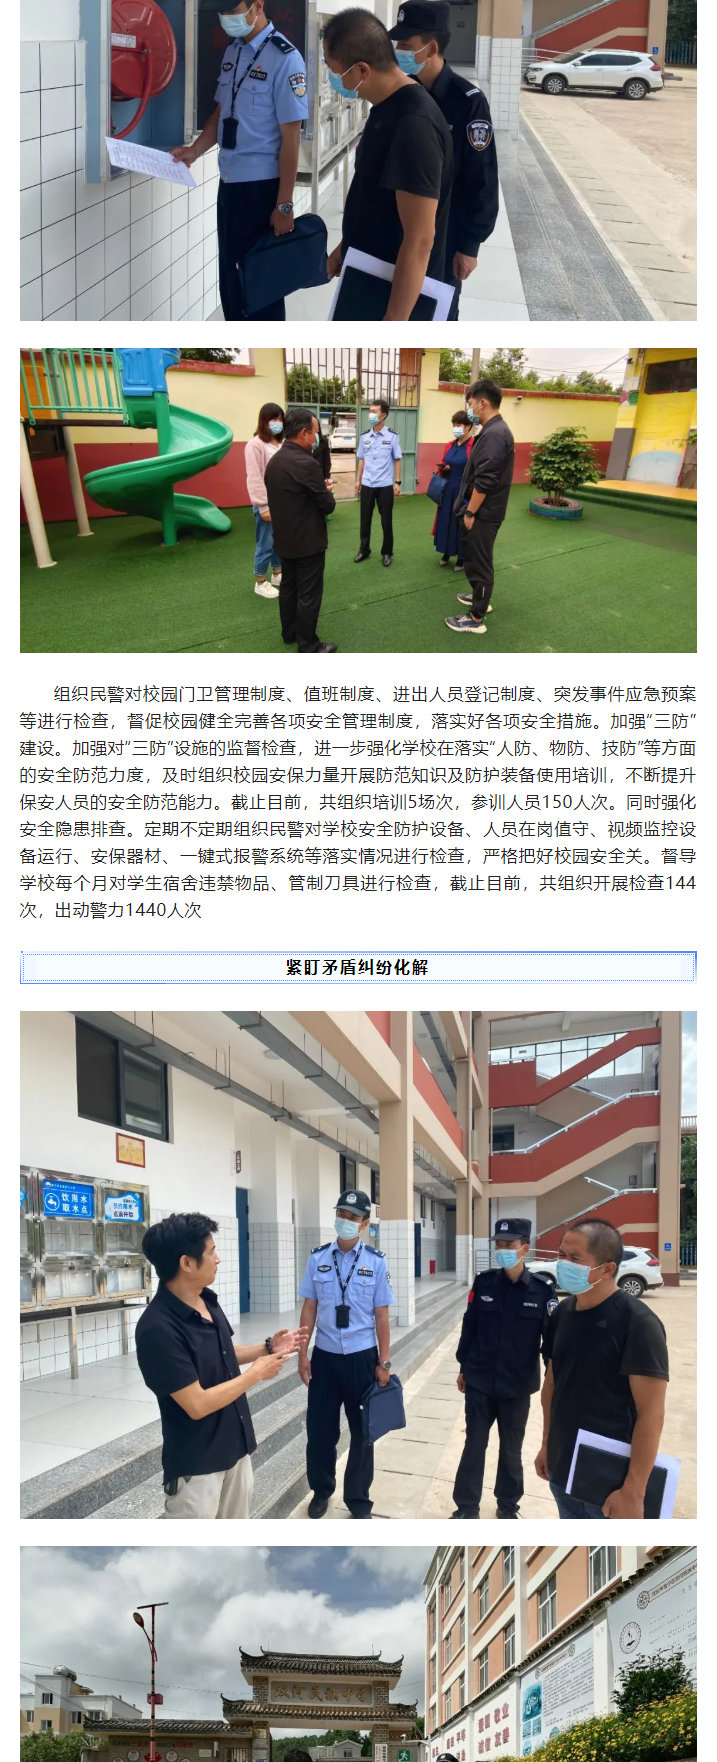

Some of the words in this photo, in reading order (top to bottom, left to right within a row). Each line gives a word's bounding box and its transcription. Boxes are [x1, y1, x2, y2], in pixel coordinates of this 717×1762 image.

[53, 684, 697, 704] 组织民警对校园门卫管理制度、值班制度、进出人员登记制度、突发事件应急预案
[19, 765, 697, 785] 的安全防范力度，及时组织校园安保力量开展防范知识及防护装备使用培训，不断提升
[19, 792, 697, 812] 保安人员的安全防范能力。截止目前，共组织培训5场次，参训人员150人次。同时强化
[19, 819, 697, 839] 安全隐患排查。定期不定期组织民警对学校安全防护设备、人员在岗值守、视频监控设
[19, 846, 697, 866] 备运行、安保器材、一键式报警系统等落实情况进行检查，严格把好校园安全关。督导
[19, 873, 697, 893] 学校每个月对学生宿舍违禁物品、管制刀具进行检查，截止目前，共组织开展检查144
[19, 901, 202, 920] 次，出动警力1440人次
[286, 958, 429, 976] 紧盯矛盾纠纷化解
[61, 1192, 88, 1203] 饮用水
[62, 1203, 88, 1214] 取水点
[274, 1685, 369, 1703] 双河民族中学
